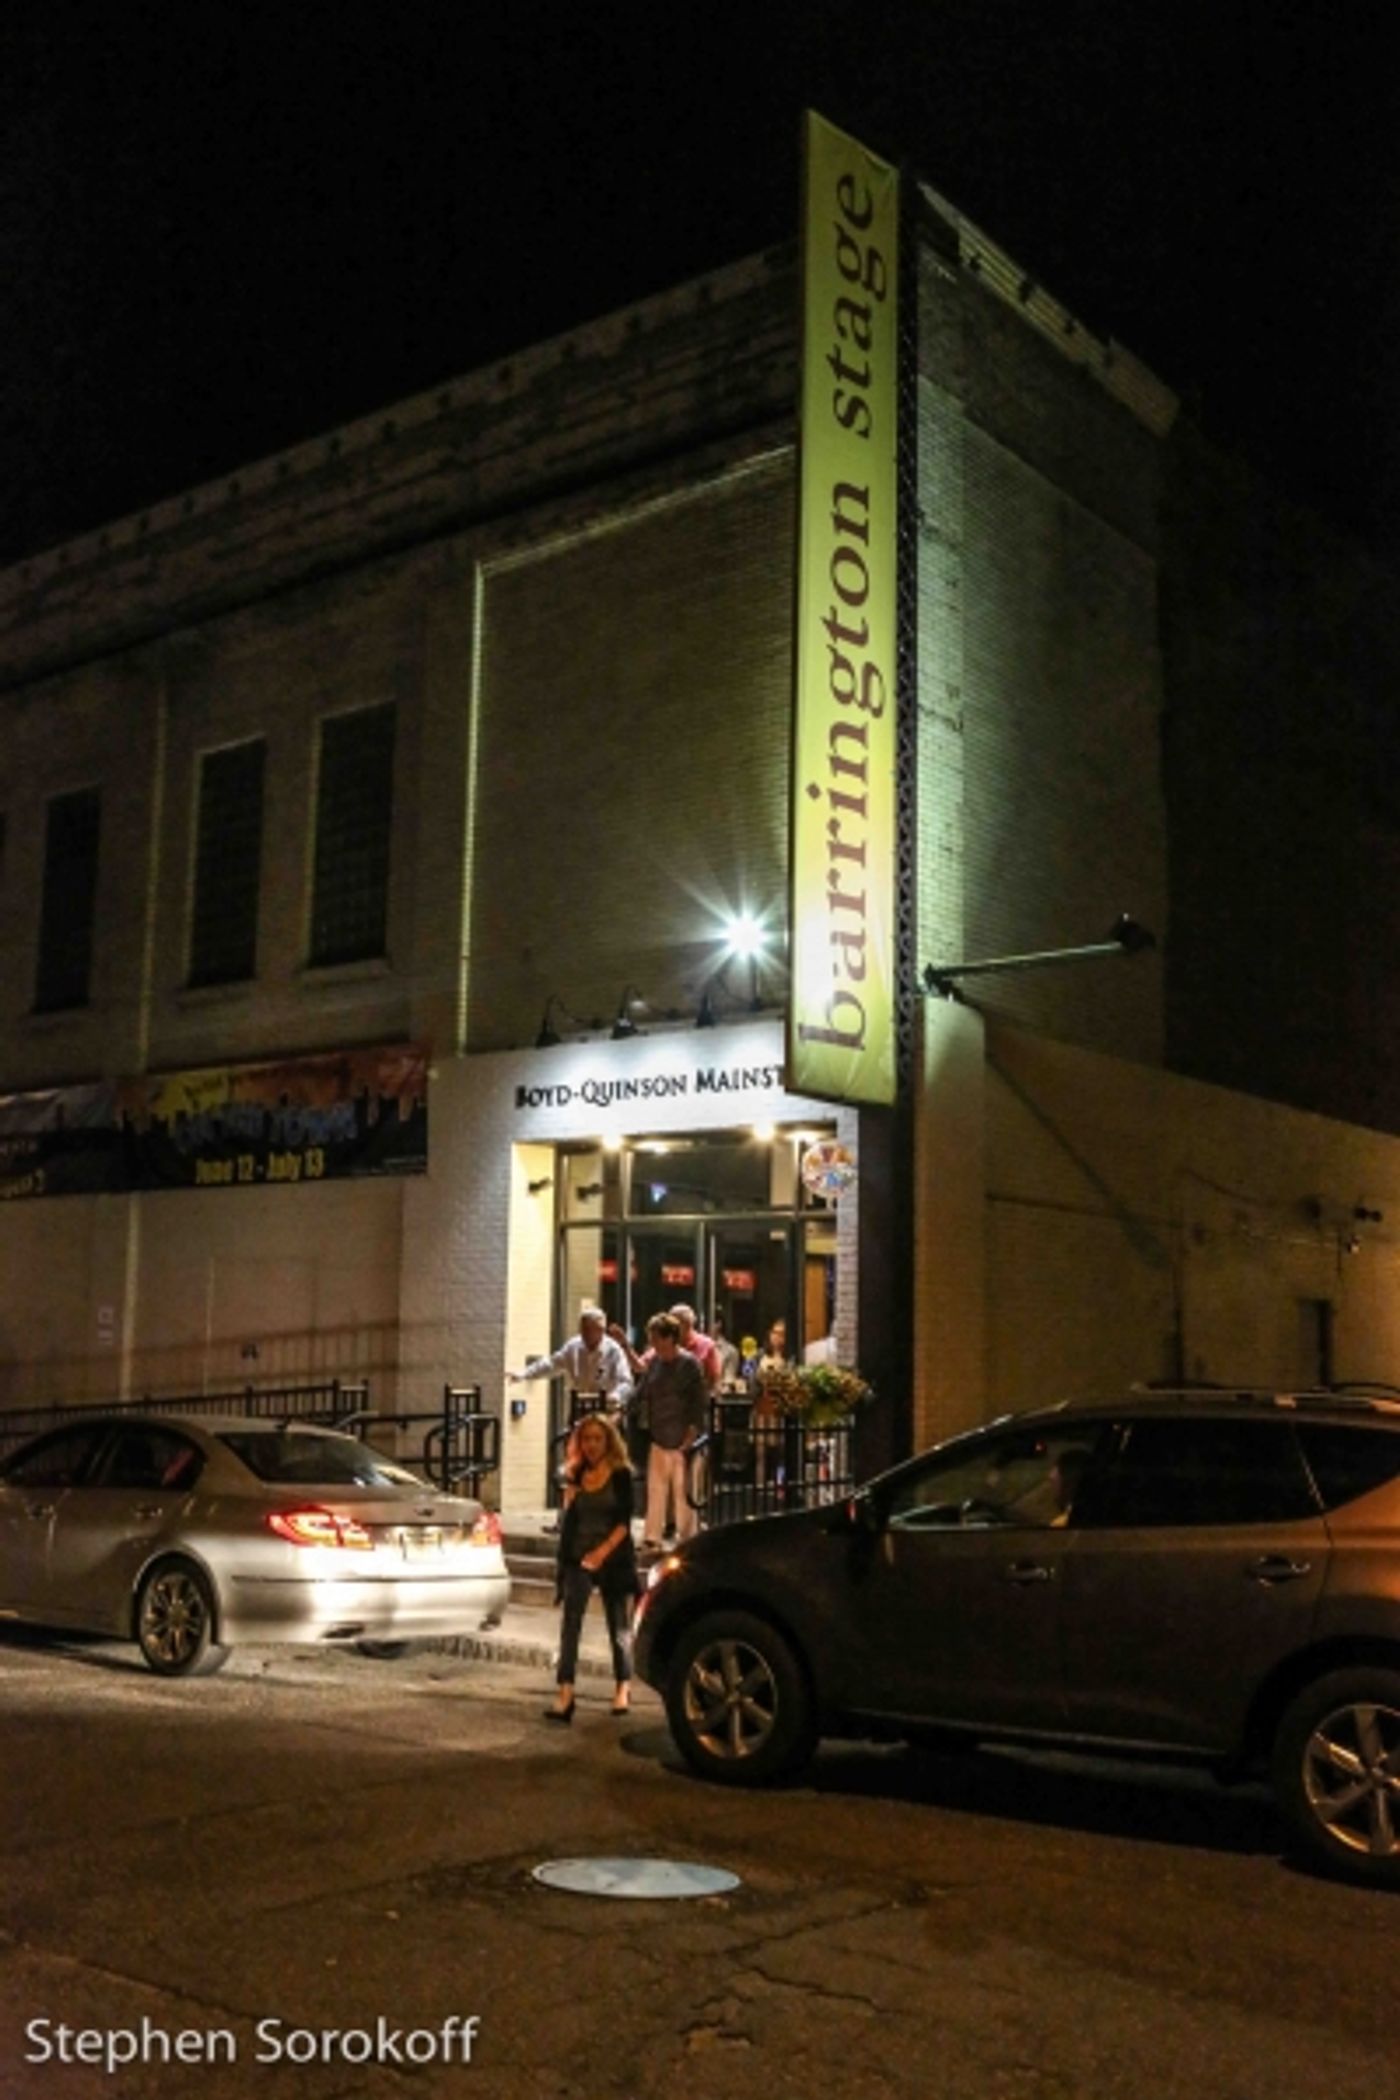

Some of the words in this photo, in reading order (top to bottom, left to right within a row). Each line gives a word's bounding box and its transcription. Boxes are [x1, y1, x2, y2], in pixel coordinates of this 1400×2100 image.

[825, 173, 888, 439] stage
[797, 482, 887, 1051] barrington
[266, 1151, 302, 1182] July
